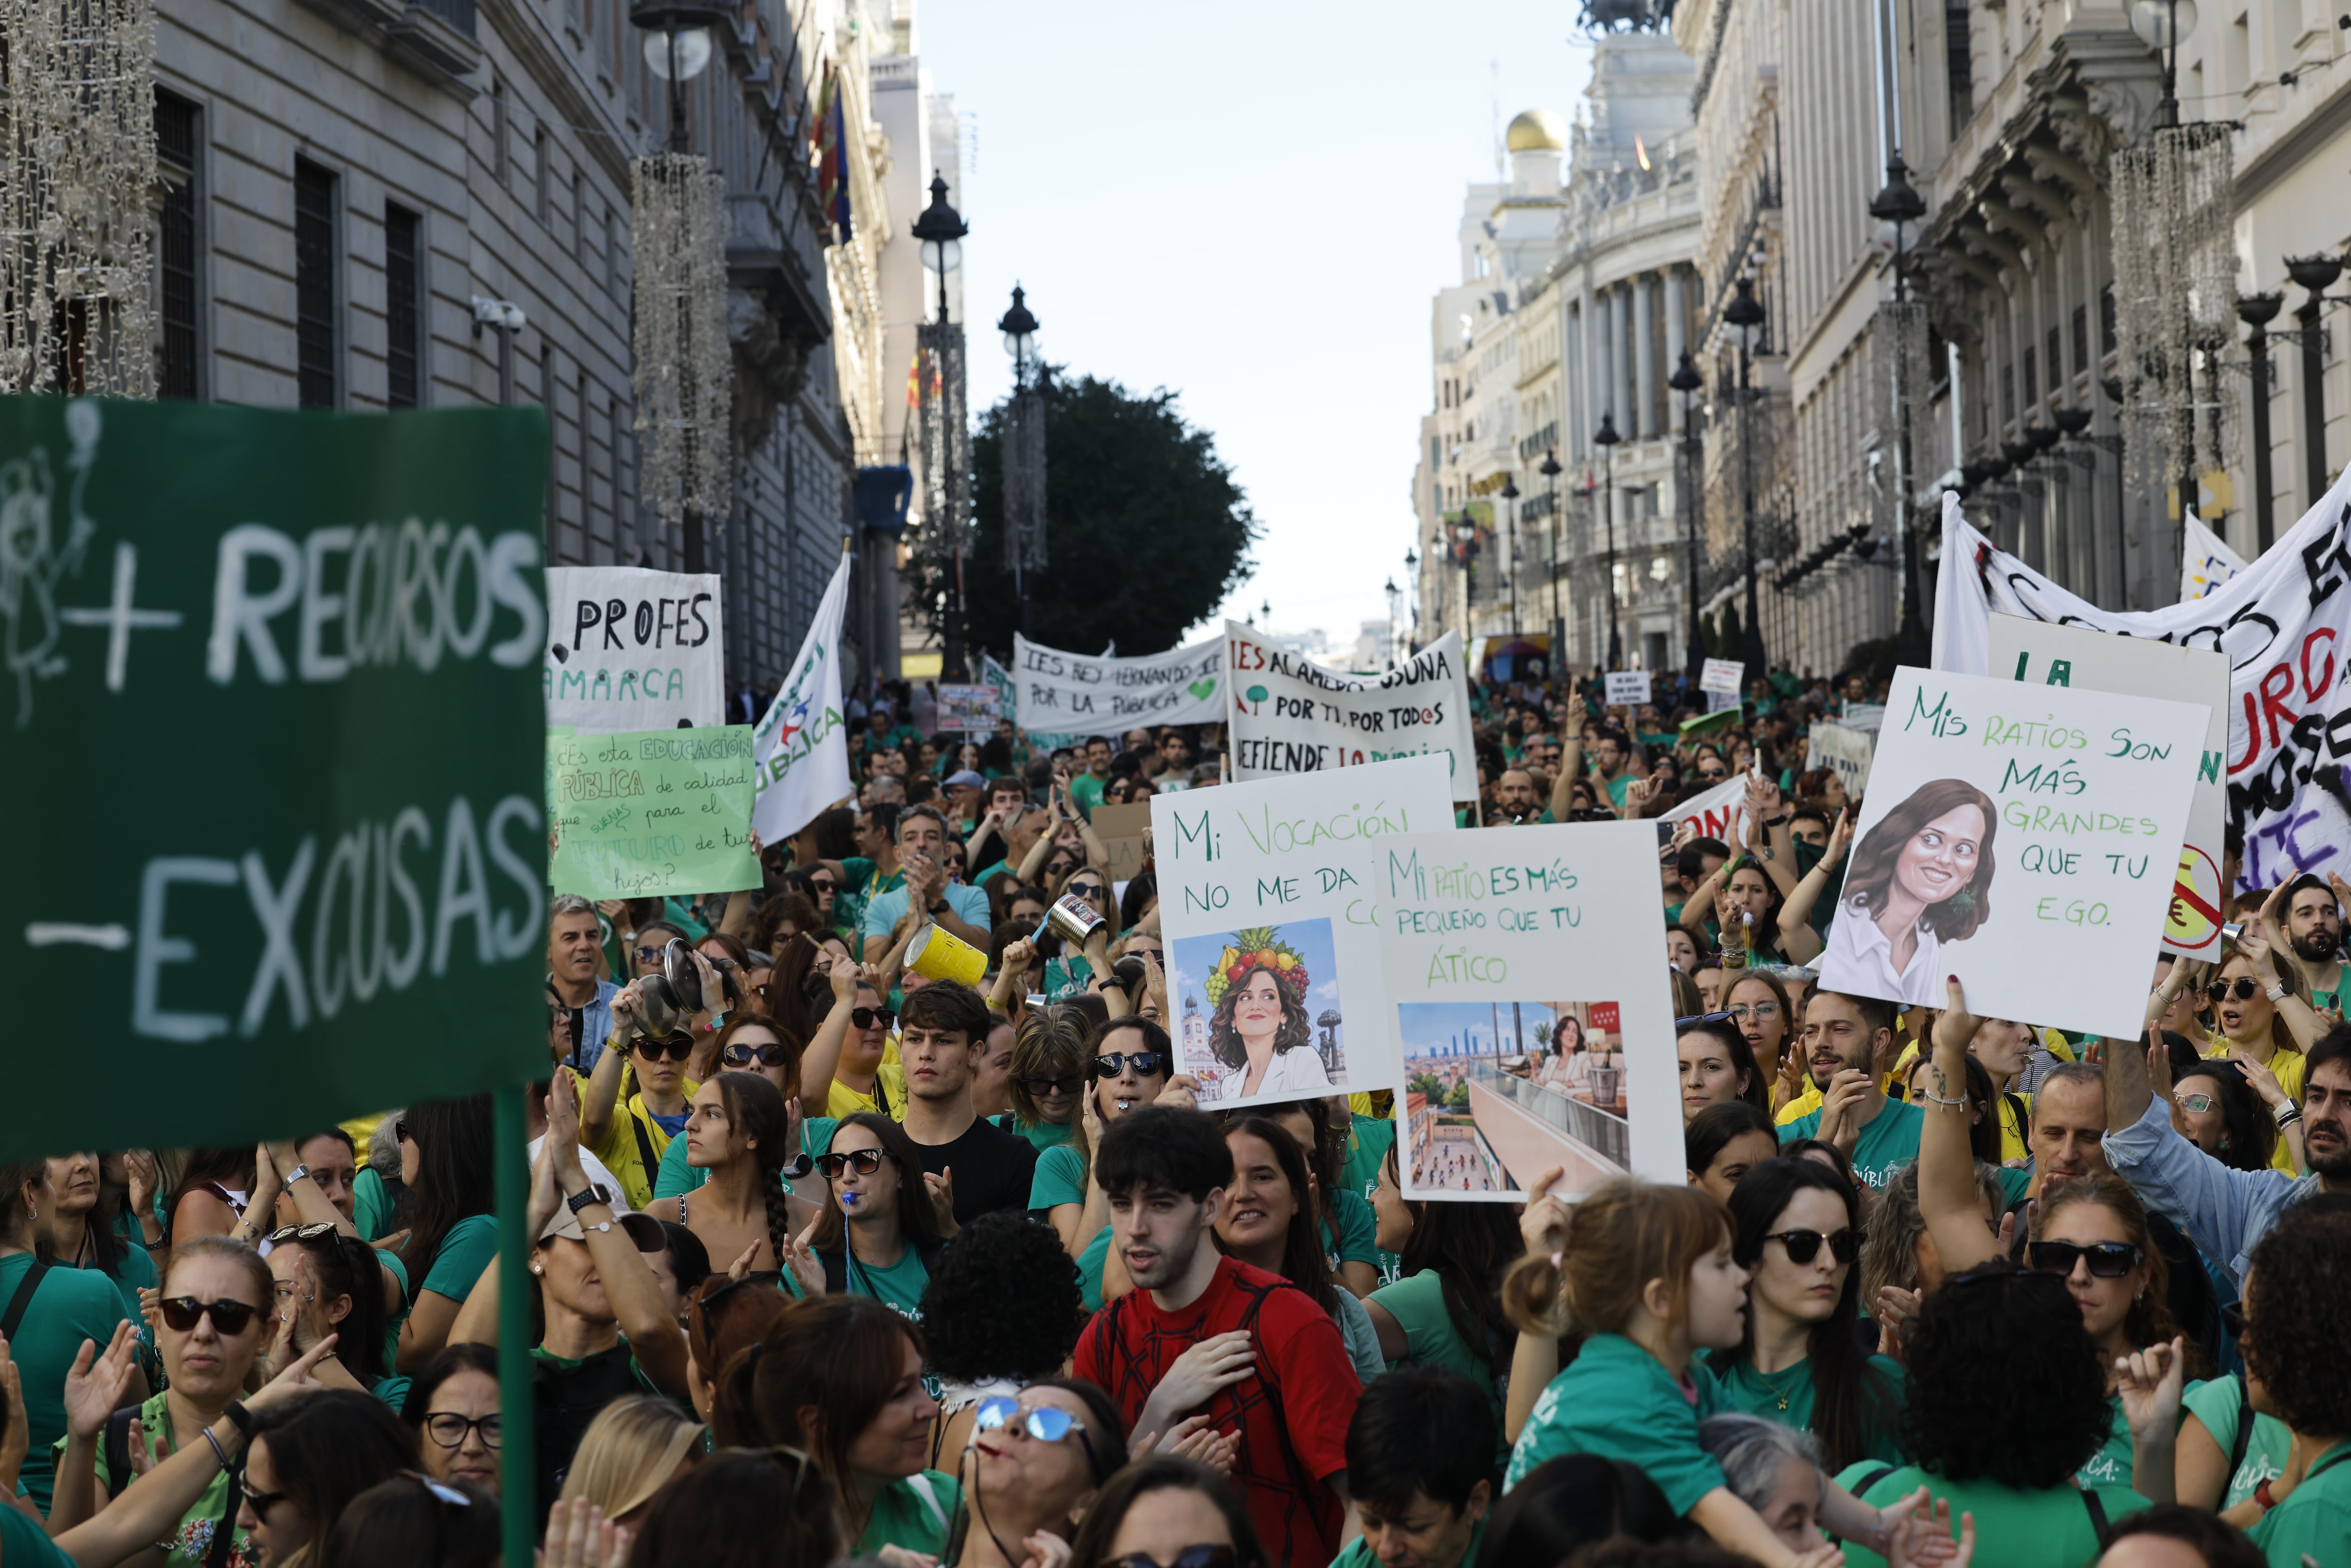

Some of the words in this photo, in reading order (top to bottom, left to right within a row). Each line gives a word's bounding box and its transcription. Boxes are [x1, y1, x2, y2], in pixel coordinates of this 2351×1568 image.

[208, 519, 545, 686] RECURSOS
[573, 593, 711, 650] PROFES
[1022, 646, 1064, 677] IES
[1072, 662, 1103, 685] REY
[1231, 641, 1265, 670] IES
[1030, 683, 1059, 709] POR
[1072, 693, 1095, 714] LA
[1276, 696, 1315, 720] POR
[1348, 711, 1385, 733] POR
[1389, 702, 1444, 730] TOD@S
[599, 736, 632, 763] esta
[558, 768, 645, 803] PÚBLICA
[656, 774, 673, 794] de
[684, 769, 749, 790] calidad
[1998, 758, 2086, 796] MÁS
[558, 815, 580, 839] que
[646, 806, 685, 828] para
[702, 793, 721, 814] el
[2004, 800, 2158, 837] GRANDES
[571, 835, 685, 864] FUTURO
[695, 835, 715, 851] de
[2020, 844, 2082, 876] QUE
[2105, 854, 2148, 880] TU
[1185, 882, 1229, 914] NO
[1257, 876, 1300, 907] ME
[1315, 867, 1358, 894] DA
[1490, 866, 1520, 896] ES
[1526, 858, 1578, 891] MÁS
[132, 794, 543, 1041] EXCUSAS
[1397, 905, 1486, 935] PEQUEÑO
[1497, 907, 1538, 933] QUE
[1550, 906, 1581, 928] TU
